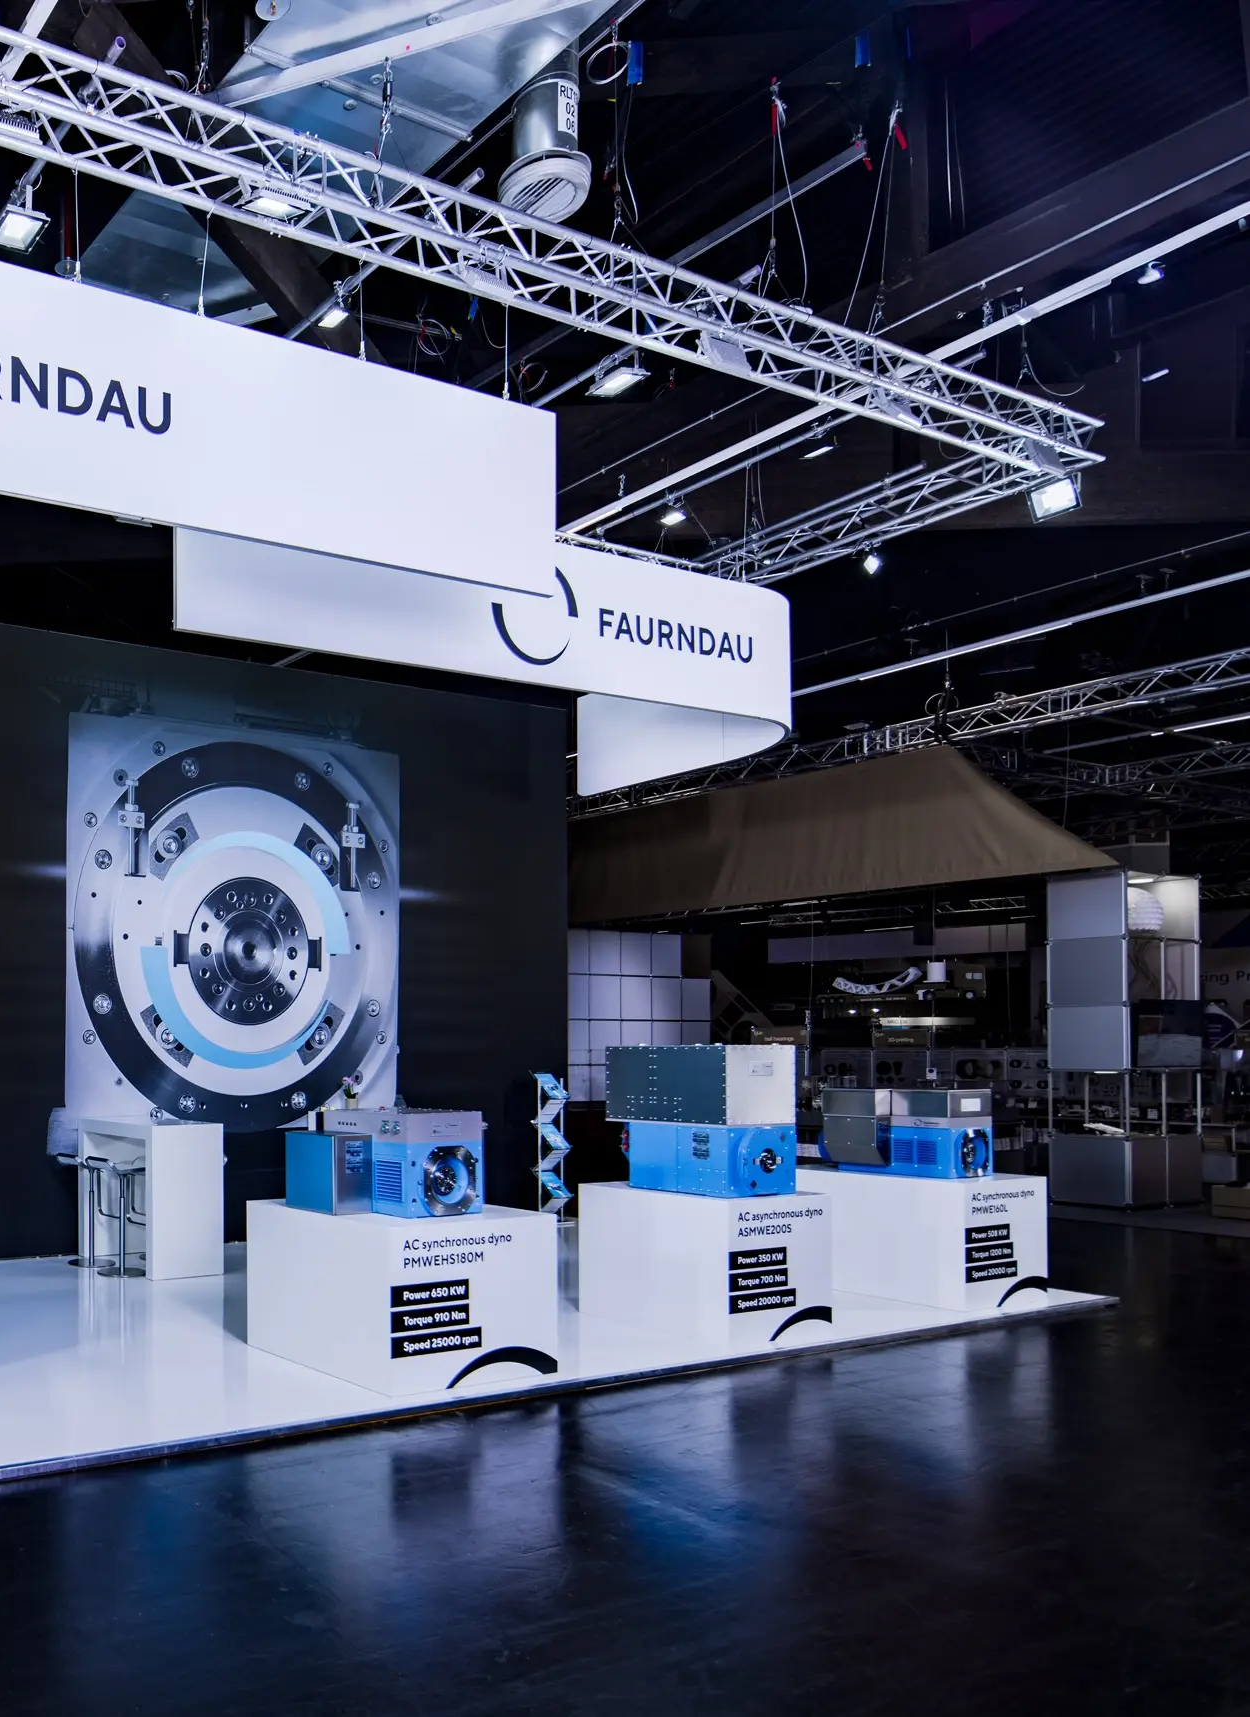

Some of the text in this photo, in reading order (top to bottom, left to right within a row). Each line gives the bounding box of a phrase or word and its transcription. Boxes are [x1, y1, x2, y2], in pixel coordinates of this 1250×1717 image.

[565, 102, 575, 118] 02
[599, 607, 754, 664] FAURNDAU
[971, 1189, 1034, 1203] AC synchronous dyno
[737, 1207, 823, 1223] AC asynchronous dyno
[737, 1223, 792, 1237] ASMWE200S
[971, 1232, 987, 1240] Power
[402, 1232, 513, 1252] AC synchronous dyno
[403, 1251, 485, 1269] PMWEHS180M
[737, 1252, 784, 1265] Power 350 KW
[972, 1251, 989, 1259] Torque
[1002, 1247, 1012, 1255] Nm
[971, 1270, 988, 1279] Speed
[1005, 1266, 1016, 1274] rpm
[737, 1274, 786, 1287] Torque 700 Nm
[403, 1285, 466, 1301] Power 650 KW
[737, 1295, 794, 1309] Speed 20000 rpm
[403, 1310, 466, 1327] Torque 910 Nm
[403, 1334, 479, 1352] Speed 25000 rpm
